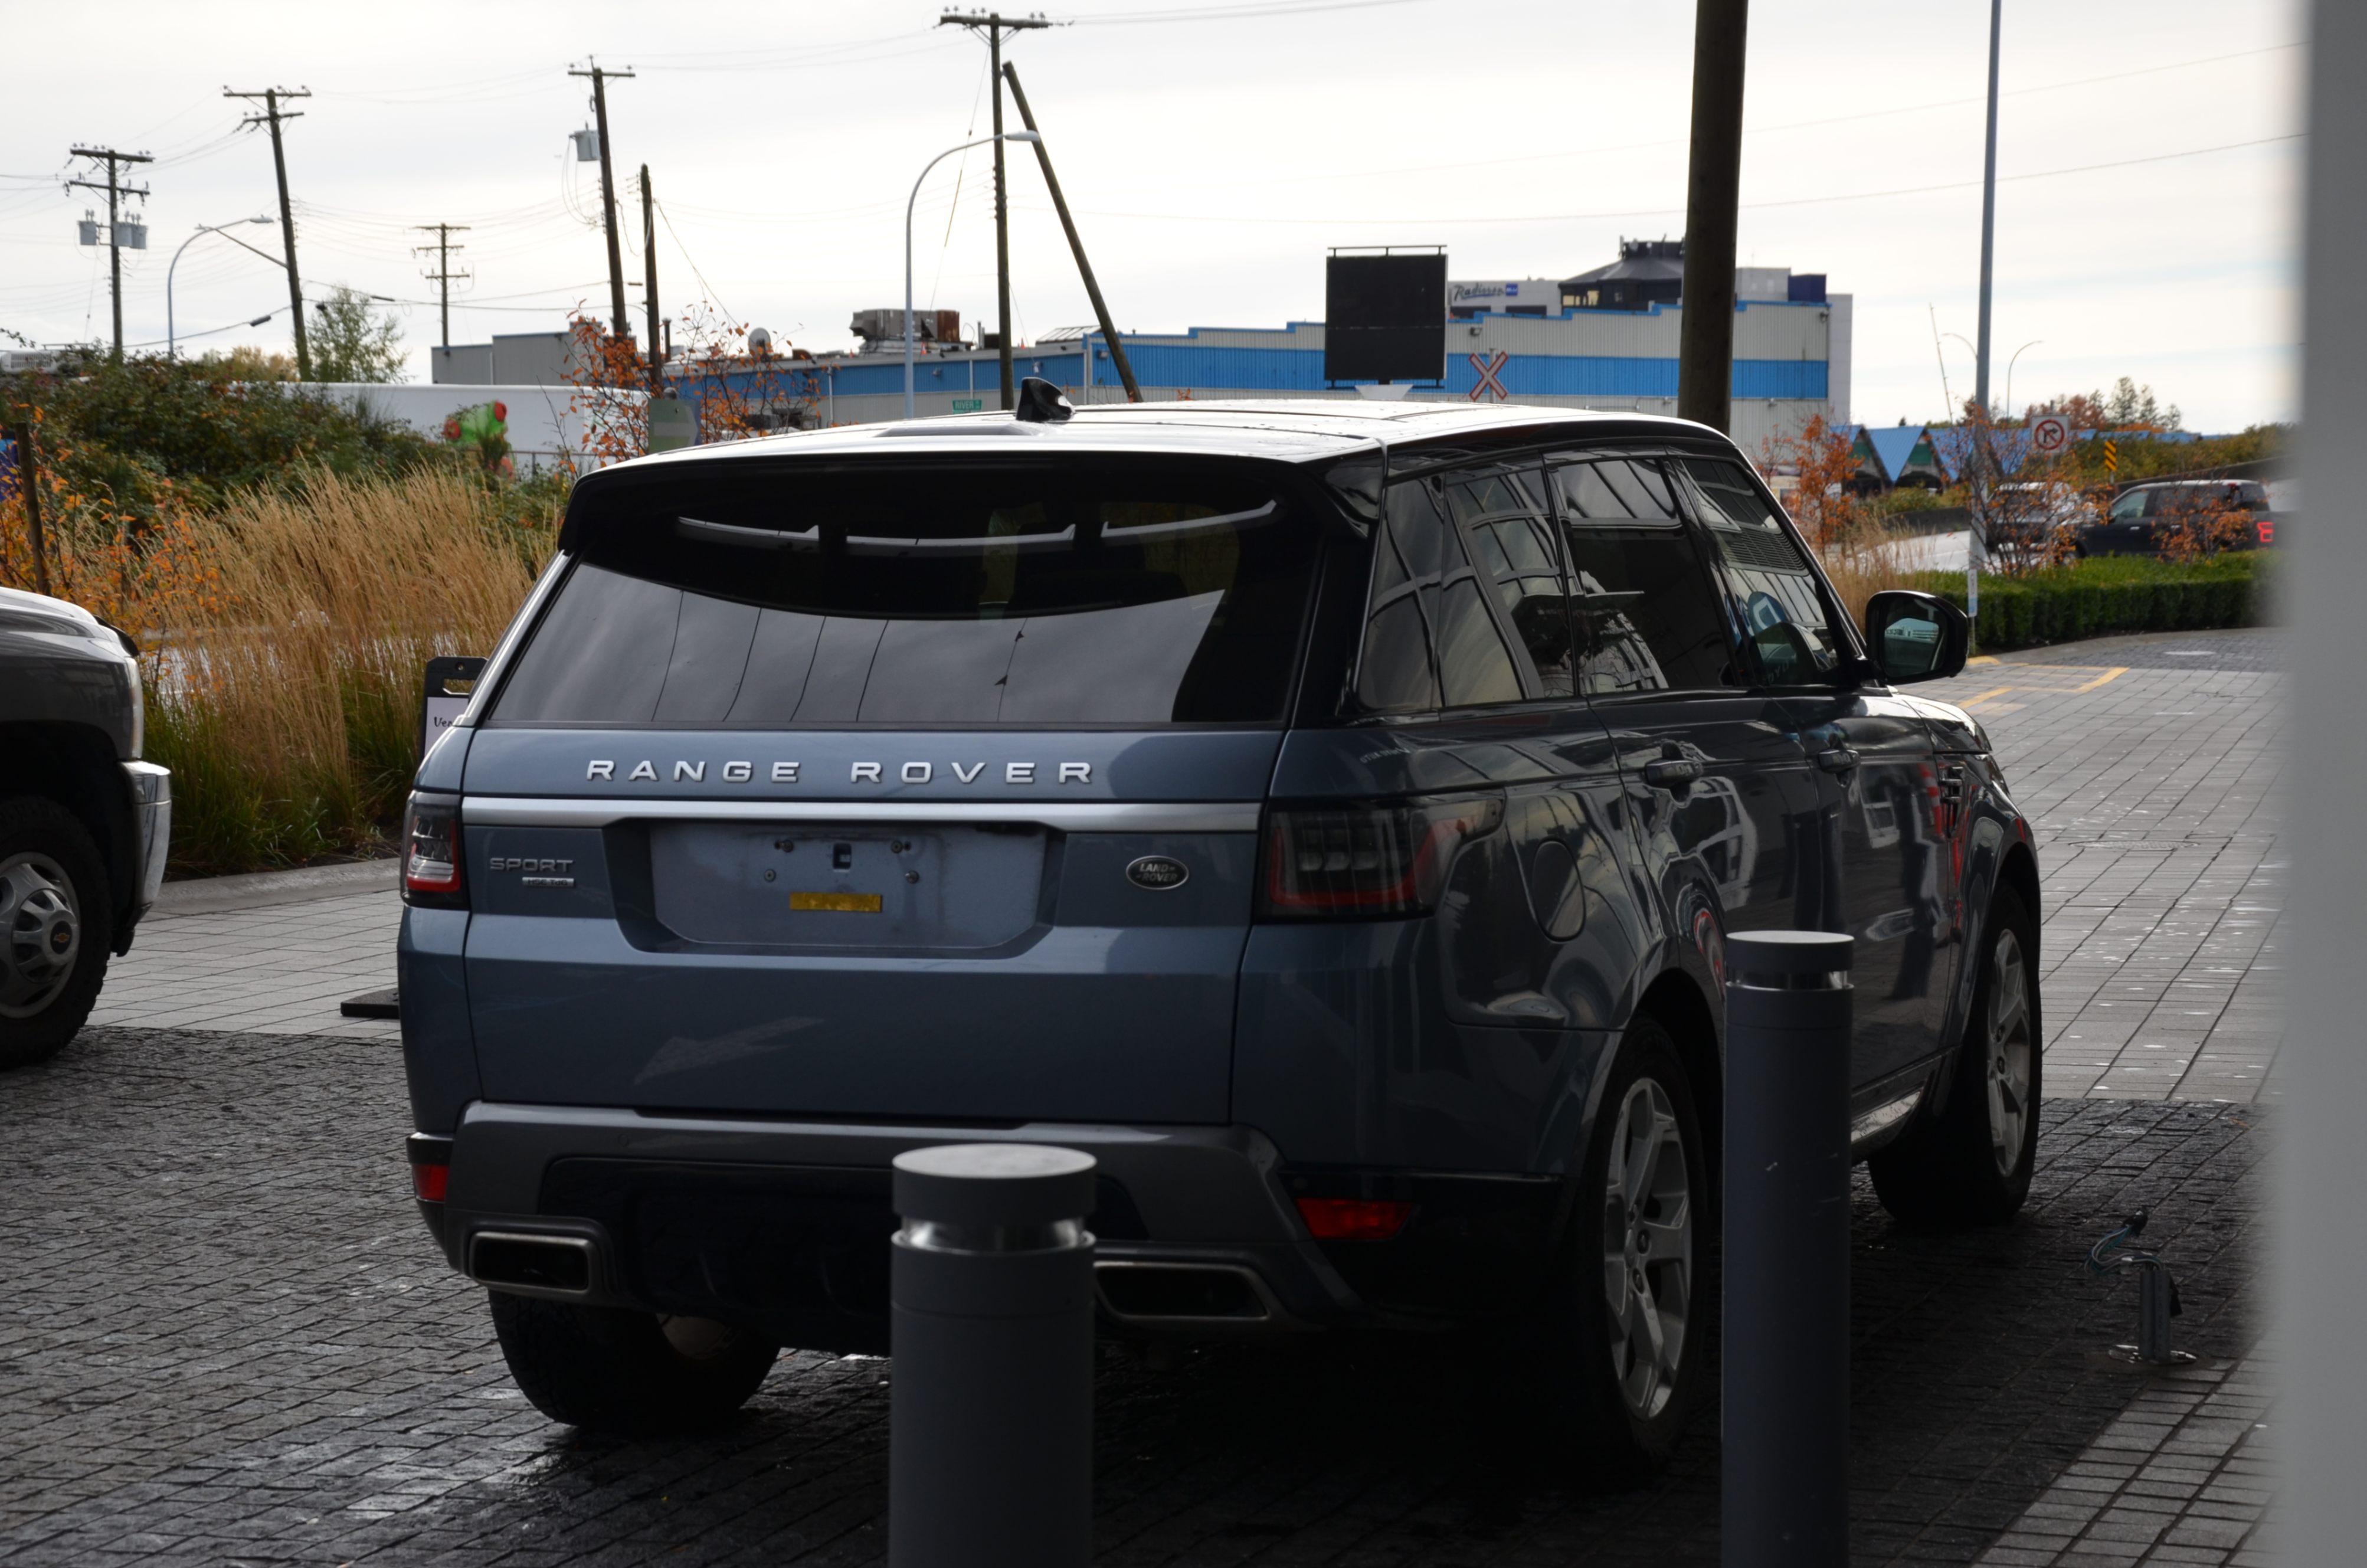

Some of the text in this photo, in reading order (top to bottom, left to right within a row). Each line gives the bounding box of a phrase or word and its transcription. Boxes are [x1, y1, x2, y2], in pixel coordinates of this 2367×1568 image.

[955, 401, 974, 410] RIVER
[586, 760, 1092, 784] RANGE ROVER
[489, 857, 574, 872] SPORT
[1140, 863, 1168, 872] LAND
[1142, 873, 1178, 882] ROVER
